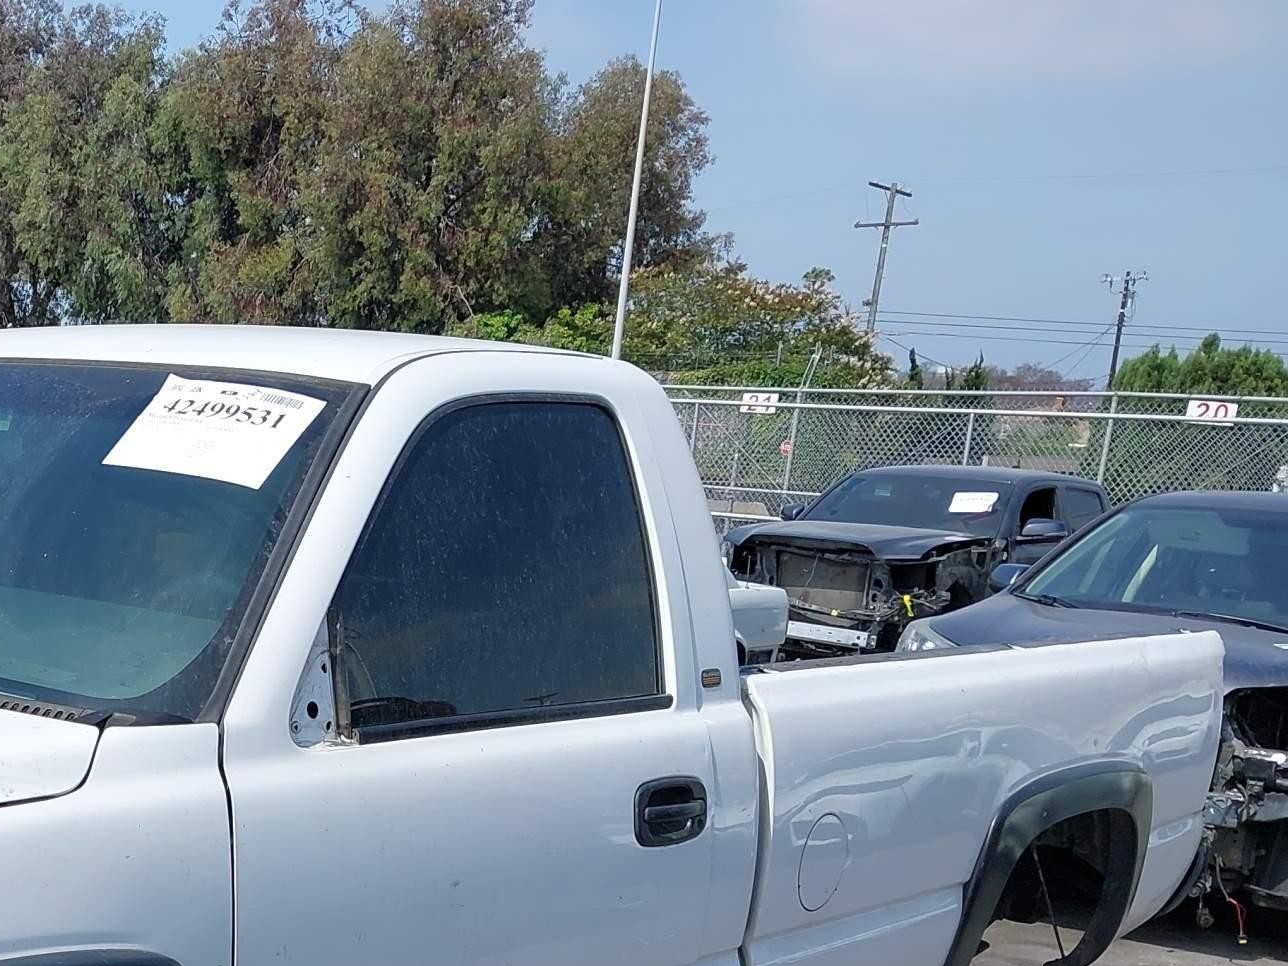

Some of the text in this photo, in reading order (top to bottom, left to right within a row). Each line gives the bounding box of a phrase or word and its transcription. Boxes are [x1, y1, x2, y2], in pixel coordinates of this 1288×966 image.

[746, 395, 771, 412] 21
[1197, 402, 1229, 418] 20
[163, 399, 287, 429] 42499531
